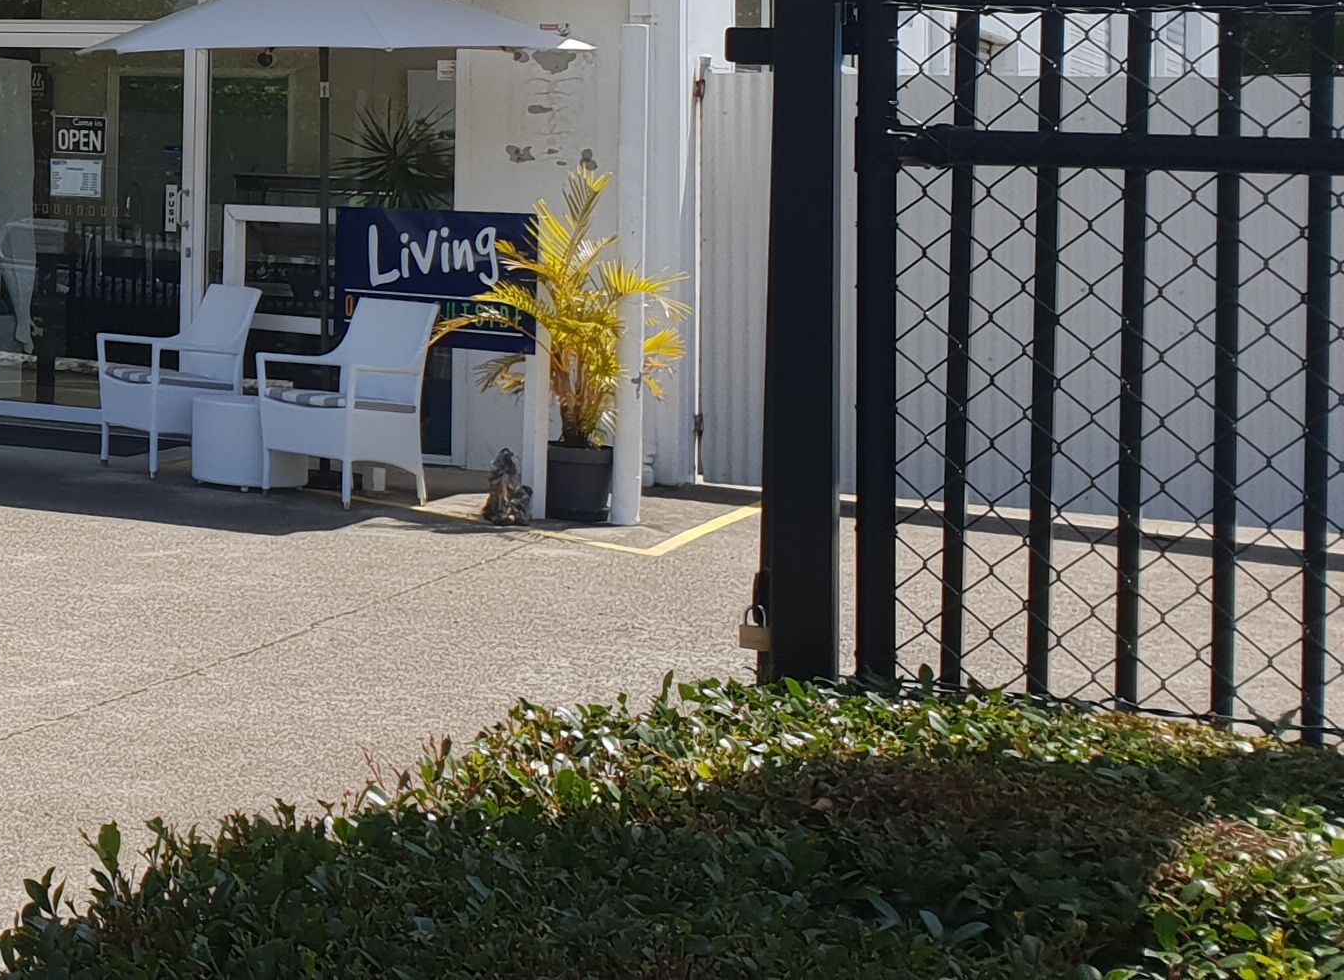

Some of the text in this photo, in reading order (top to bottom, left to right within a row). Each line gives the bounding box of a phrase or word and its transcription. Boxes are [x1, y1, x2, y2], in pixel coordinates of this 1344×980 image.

[57, 128, 102, 152] OPEN
[168, 192, 176, 225] PUSH
[368, 224, 500, 288] Living
